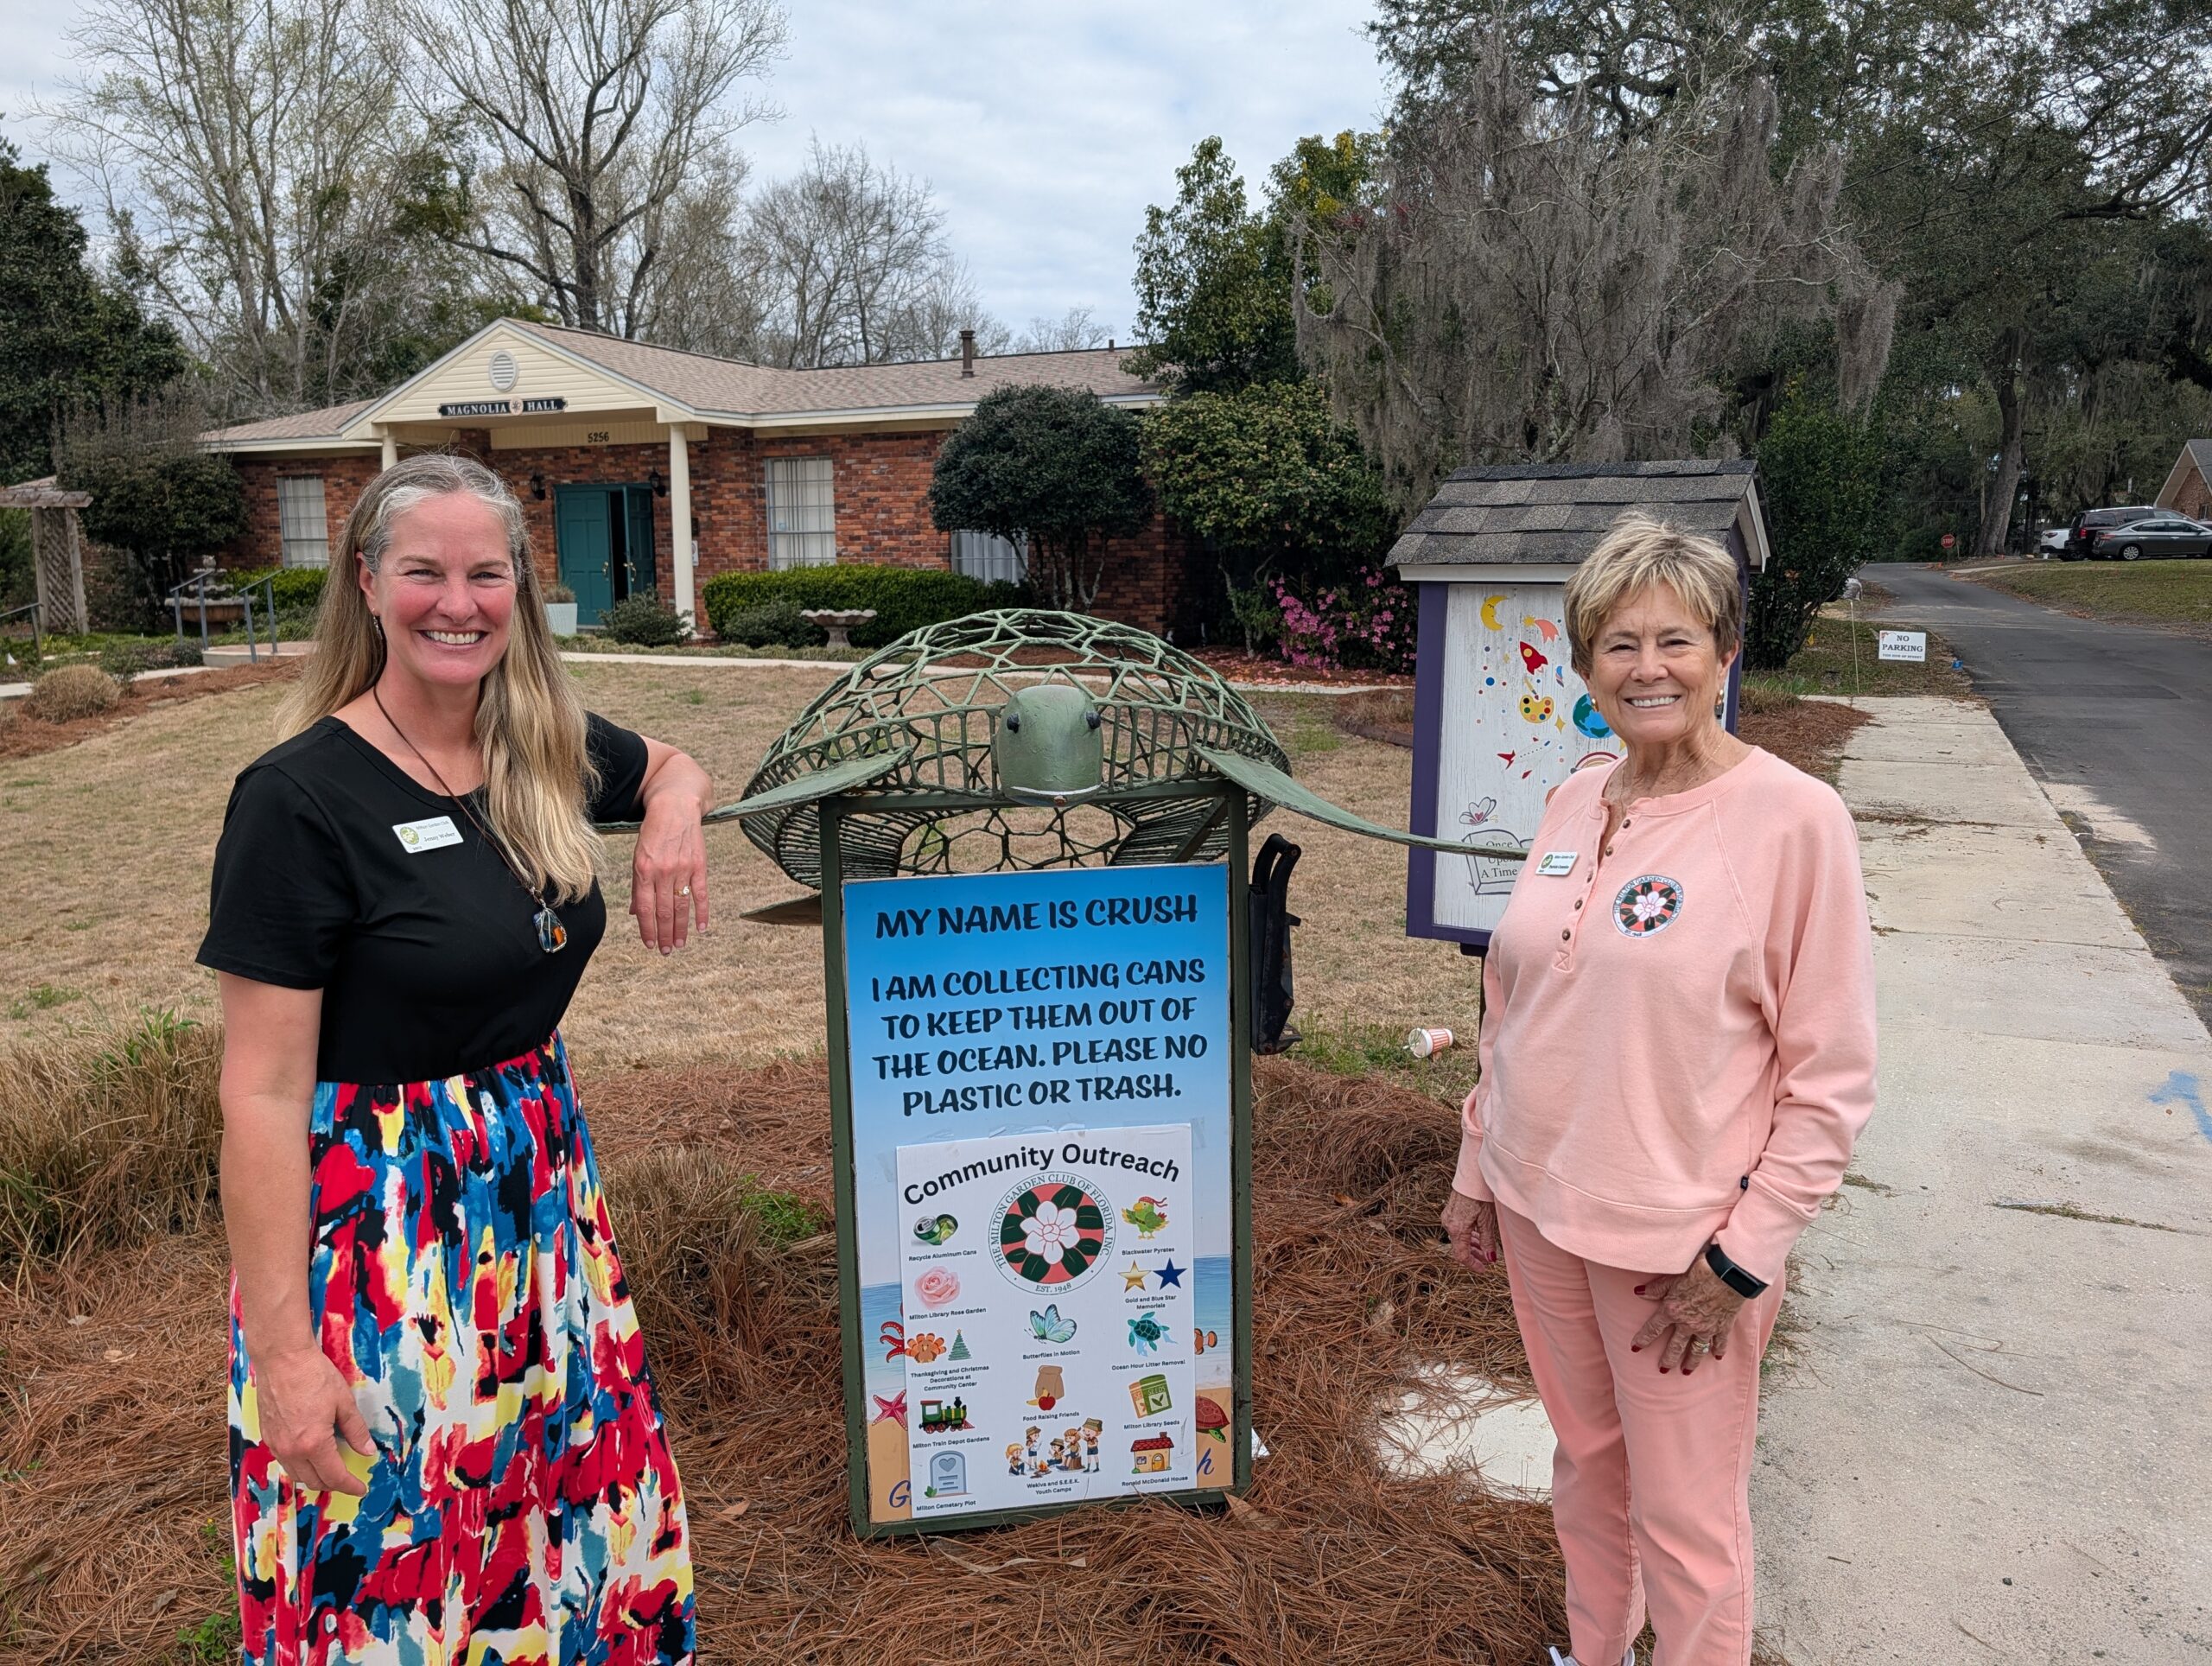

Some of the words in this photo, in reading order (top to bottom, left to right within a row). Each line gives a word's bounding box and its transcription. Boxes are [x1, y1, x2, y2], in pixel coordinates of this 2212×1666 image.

[447, 403, 507, 416] MAGNOLIA
[527, 400, 557, 411] HALL
[588, 431, 609, 443] 5256
[1882, 644, 1923, 652] PARKING
[1481, 869, 1490, 878] A
[1491, 868, 1518, 877] Time
[875, 907, 932, 938] MY
[938, 902, 1042, 936] NAME
[1049, 900, 1078, 929] IS
[1084, 894, 1198, 926] CRUSH
[871, 977, 880, 1002] I
[885, 974, 937, 1002] AM
[943, 963, 1120, 997] COLLECTING
[1126, 957, 1205, 986] CANS
[881, 1014, 920, 1040] TO
[927, 1008, 1002, 1037] KEEP
[1007, 1002, 1092, 1031] THEM
[1098, 998, 1156, 1025] OUT
[1161, 996, 1198, 1021] OF
[872, 1052, 932, 1079] THE
[938, 1044, 1046, 1075] OCEAN.
[1052, 1037, 1159, 1065] PLEASE
[1165, 1033, 1208, 1060] NO
[903, 1083, 1023, 1116] PLASTIC
[1028, 1079, 1071, 1106] OR
[1075, 1074, 1182, 1102] TRASH.
[904, 1146, 1054, 1205] Community
[1062, 1143, 1179, 1183] Outreach
[1048, 1173, 1077, 1185] CLUB
[1005, 1175, 1046, 1204] GARDEN
[1077, 1180, 1092, 1192] OF
[992, 1205, 1008, 1245] MILTON
[1099, 1237, 1114, 1256] INC.
[992, 1245, 1007, 1269] THE
[1054, 1282, 1072, 1293] 1948
[1022, 1351, 1052, 1360] Butterflies
[911, 1370, 948, 1378] Thanksgiving
[930, 1375, 964, 1383] Decorations
[924, 1383, 957, 1391] Community
